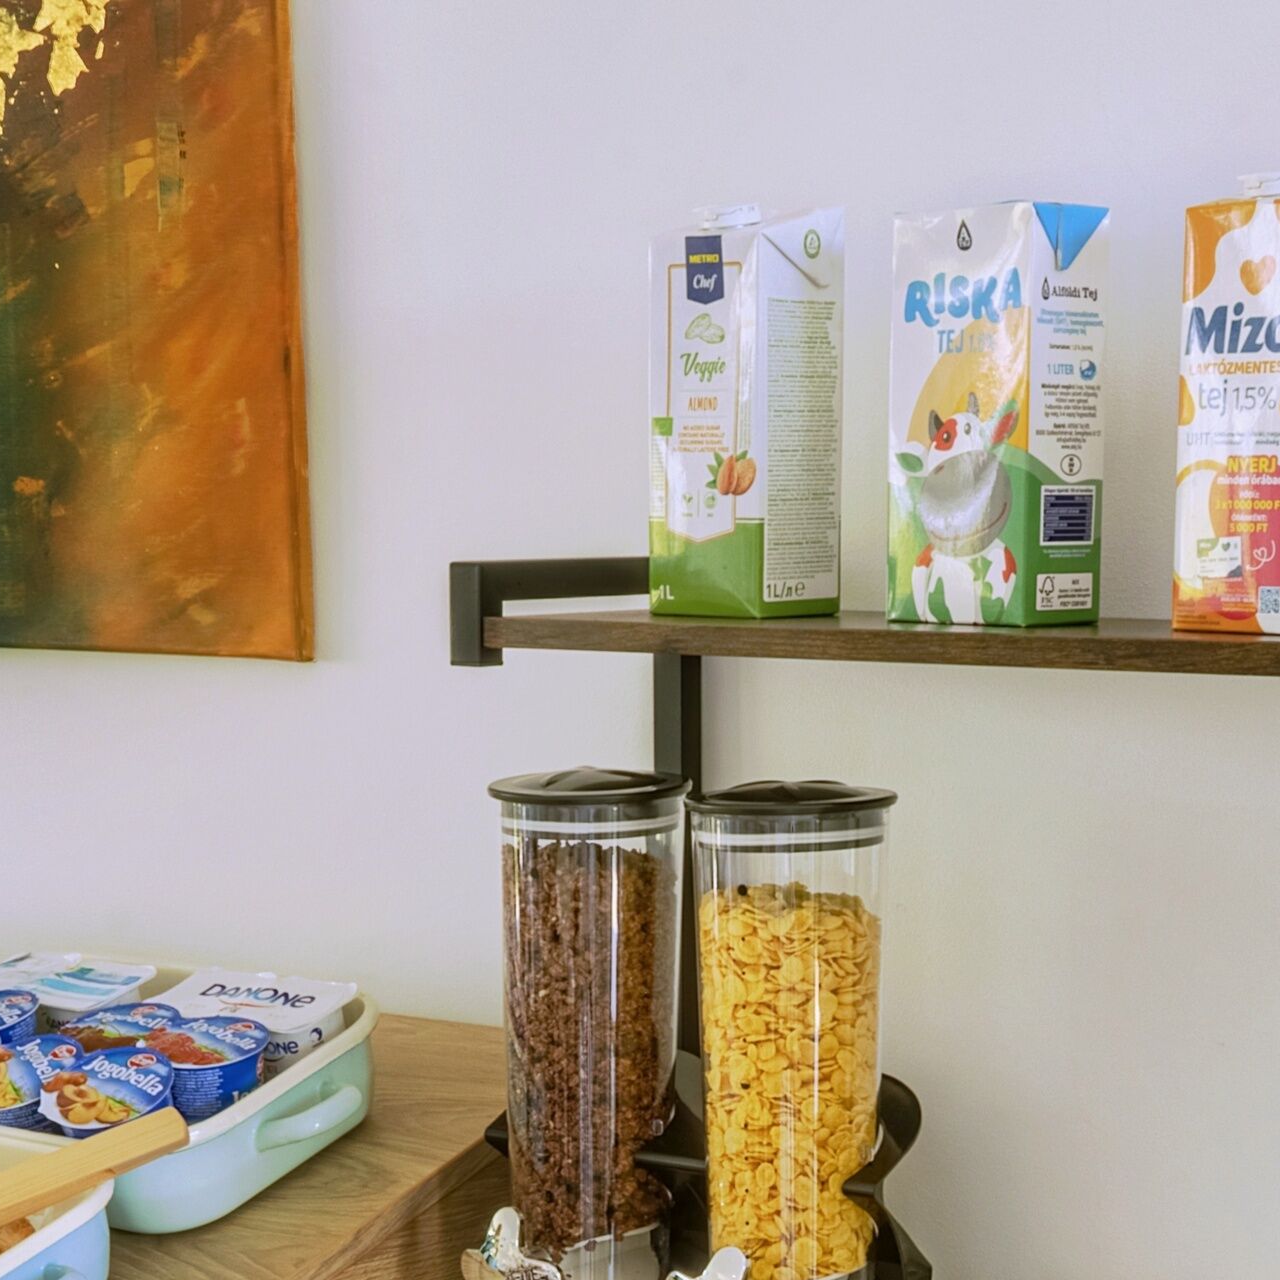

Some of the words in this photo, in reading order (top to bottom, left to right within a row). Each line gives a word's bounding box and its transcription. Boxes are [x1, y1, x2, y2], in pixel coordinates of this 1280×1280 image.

[688, 253, 720, 265] METRO
[692, 274, 718, 293] Chef
[1082, 287, 1098, 302] Tej
[904, 267, 1022, 328] RISKA
[937, 329, 964, 354] TEJ
[680, 351, 727, 383] Veggie
[687, 397, 718, 412] ALMOND
[1198, 378, 1228, 417] tej
[1232, 385, 1277, 412] 1,5%
[1227, 455, 1278, 474] NYERJ
[81, 1055, 164, 1096] Jogobella
